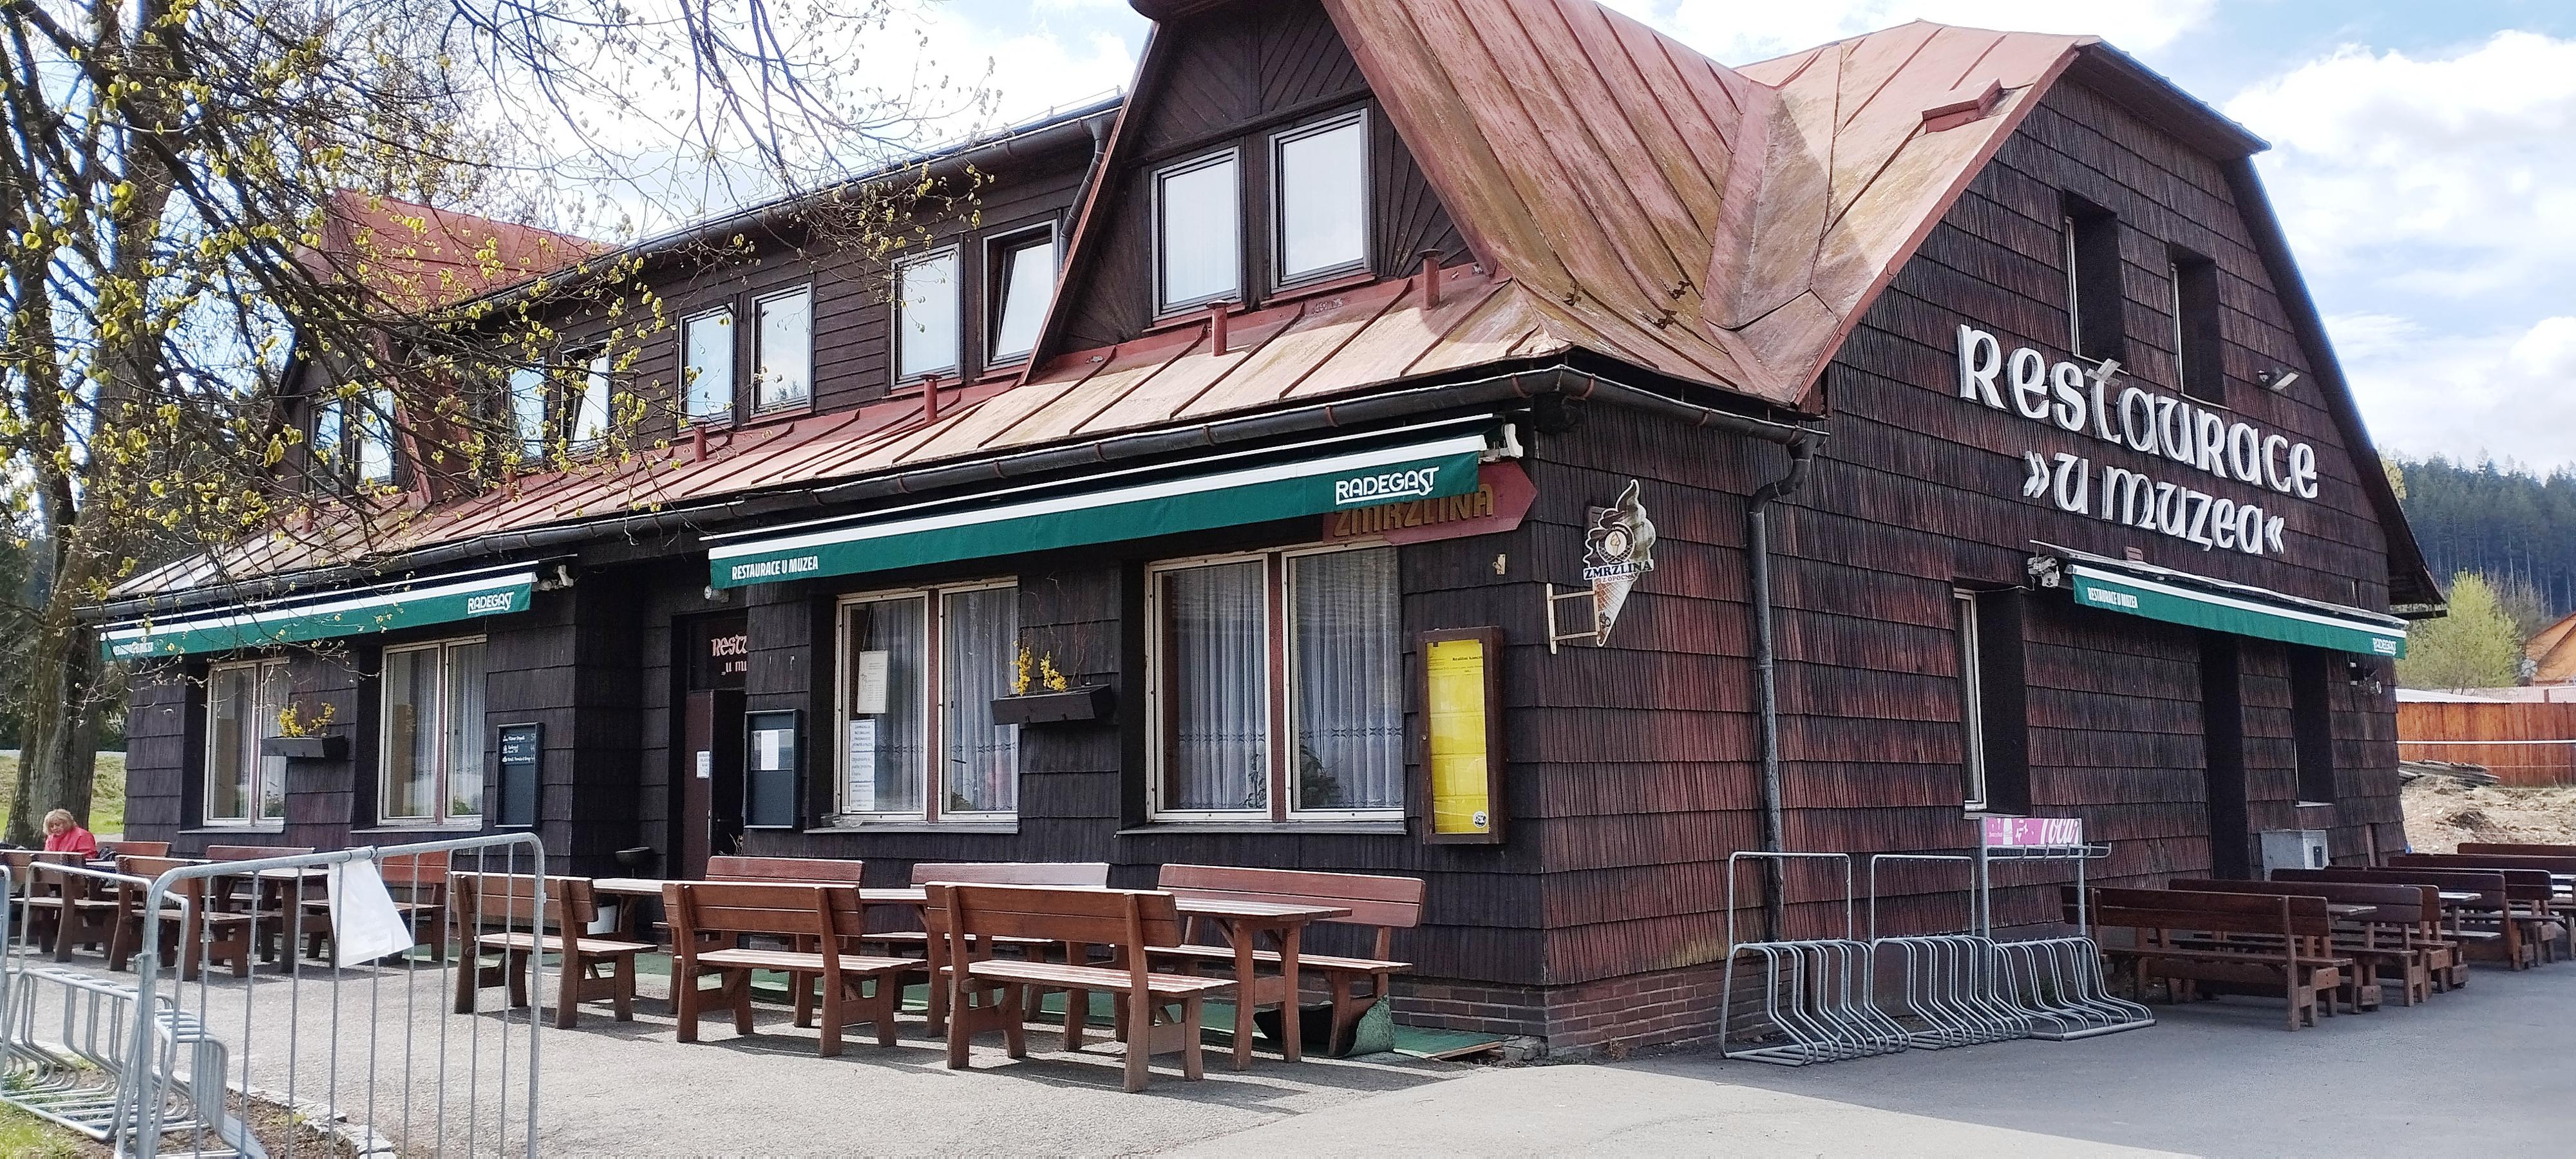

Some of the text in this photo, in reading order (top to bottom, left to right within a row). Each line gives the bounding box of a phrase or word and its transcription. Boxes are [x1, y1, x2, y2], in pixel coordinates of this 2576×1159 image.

[1335, 466, 1439, 505] RADEGAST
[732, 556, 819, 580] RESTAURACE U MUZEA
[1585, 561, 1653, 579] ZMRZLINA
[468, 591, 515, 615] RADEGAST
